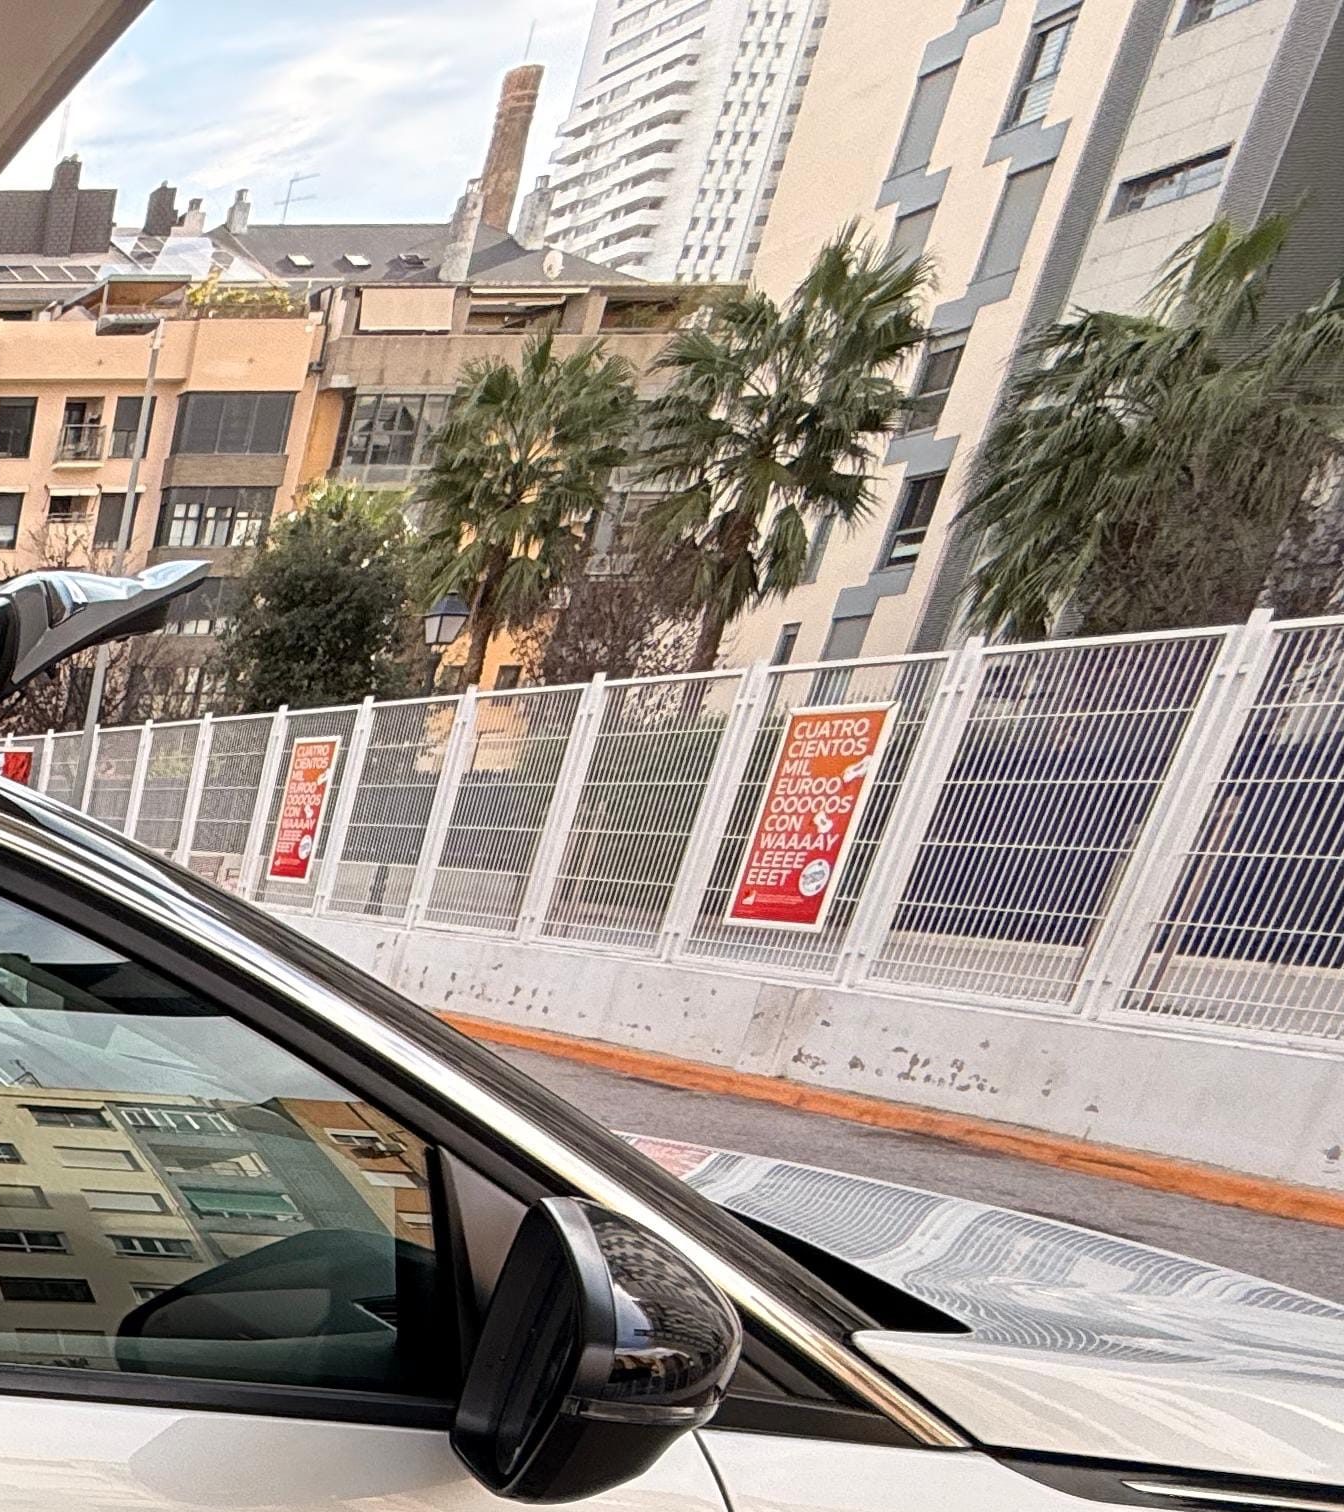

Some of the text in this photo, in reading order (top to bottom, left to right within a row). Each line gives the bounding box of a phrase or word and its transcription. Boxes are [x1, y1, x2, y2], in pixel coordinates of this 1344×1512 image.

[793, 718, 870, 739] CUATRO
[296, 745, 330, 758] CUATRO
[788, 738, 870, 758] CIENTOS
[294, 757, 329, 770] CIENTOS
[781, 760, 811, 777] MIL
[775, 777, 842, 795] EUROO
[284, 806, 301, 817] CON
[764, 815, 804, 832] CON
[760, 833, 839, 851] WAAAAY
[752, 851, 808, 869] LEEEE
[746, 869, 792, 886] EEET
